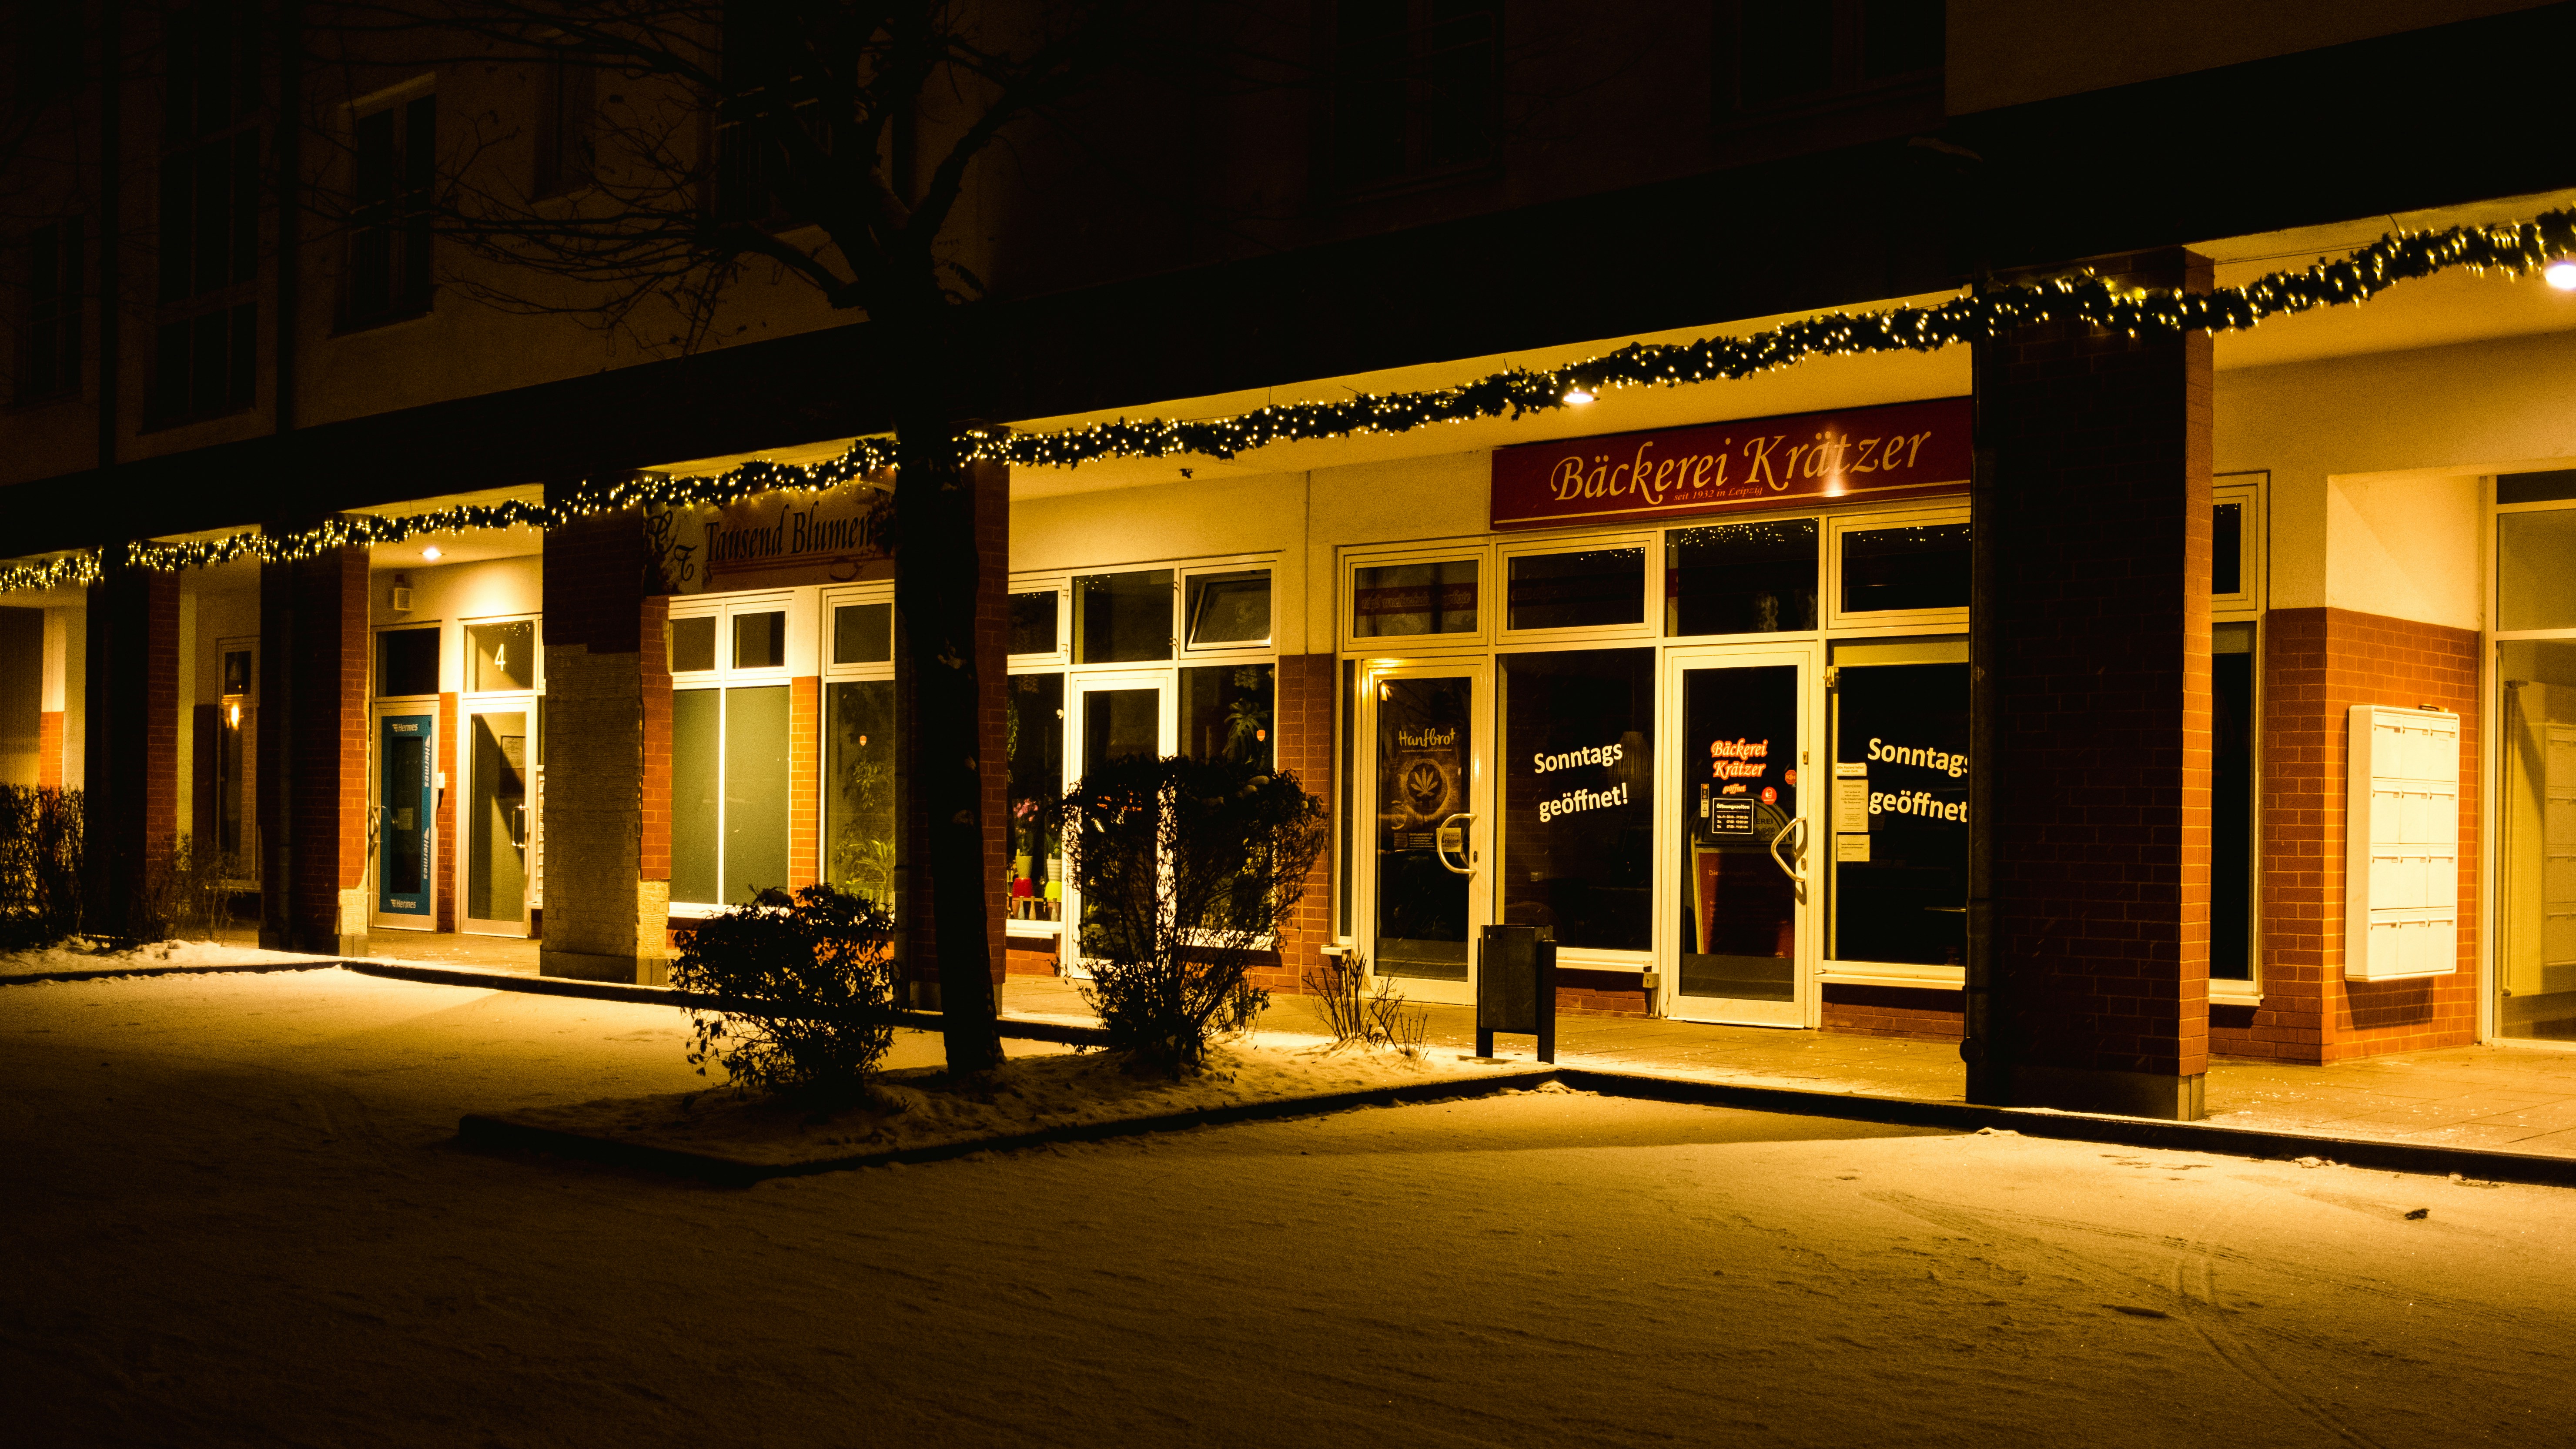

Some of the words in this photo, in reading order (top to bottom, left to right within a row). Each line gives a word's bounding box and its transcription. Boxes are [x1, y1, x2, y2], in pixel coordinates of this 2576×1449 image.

[1550, 441, 1728, 505] Bäckerei
[1743, 430, 1931, 491] Krätzer
[1673, 492, 1689, 501] seit
[1693, 490, 1714, 499] 1932
[1717, 489, 1725, 497] in
[1728, 485, 1763, 497] Leipzig
[705, 504, 790, 562] Tausend
[790, 500, 873, 555] Blumen
[494, 643, 506, 671] 4
[1398, 728, 1456, 747] Hanfbrot
[1711, 738, 1767, 760] Bäckerei
[1534, 743, 1623, 773] Sonntags
[1713, 761, 1766, 780] Krätzer
[1723, 783, 1746, 794] geöffnet
[1539, 783, 1628, 822] geöffnet!
[1869, 790, 1967, 823] geöffnet
[396, 899, 416, 908] Hermes
